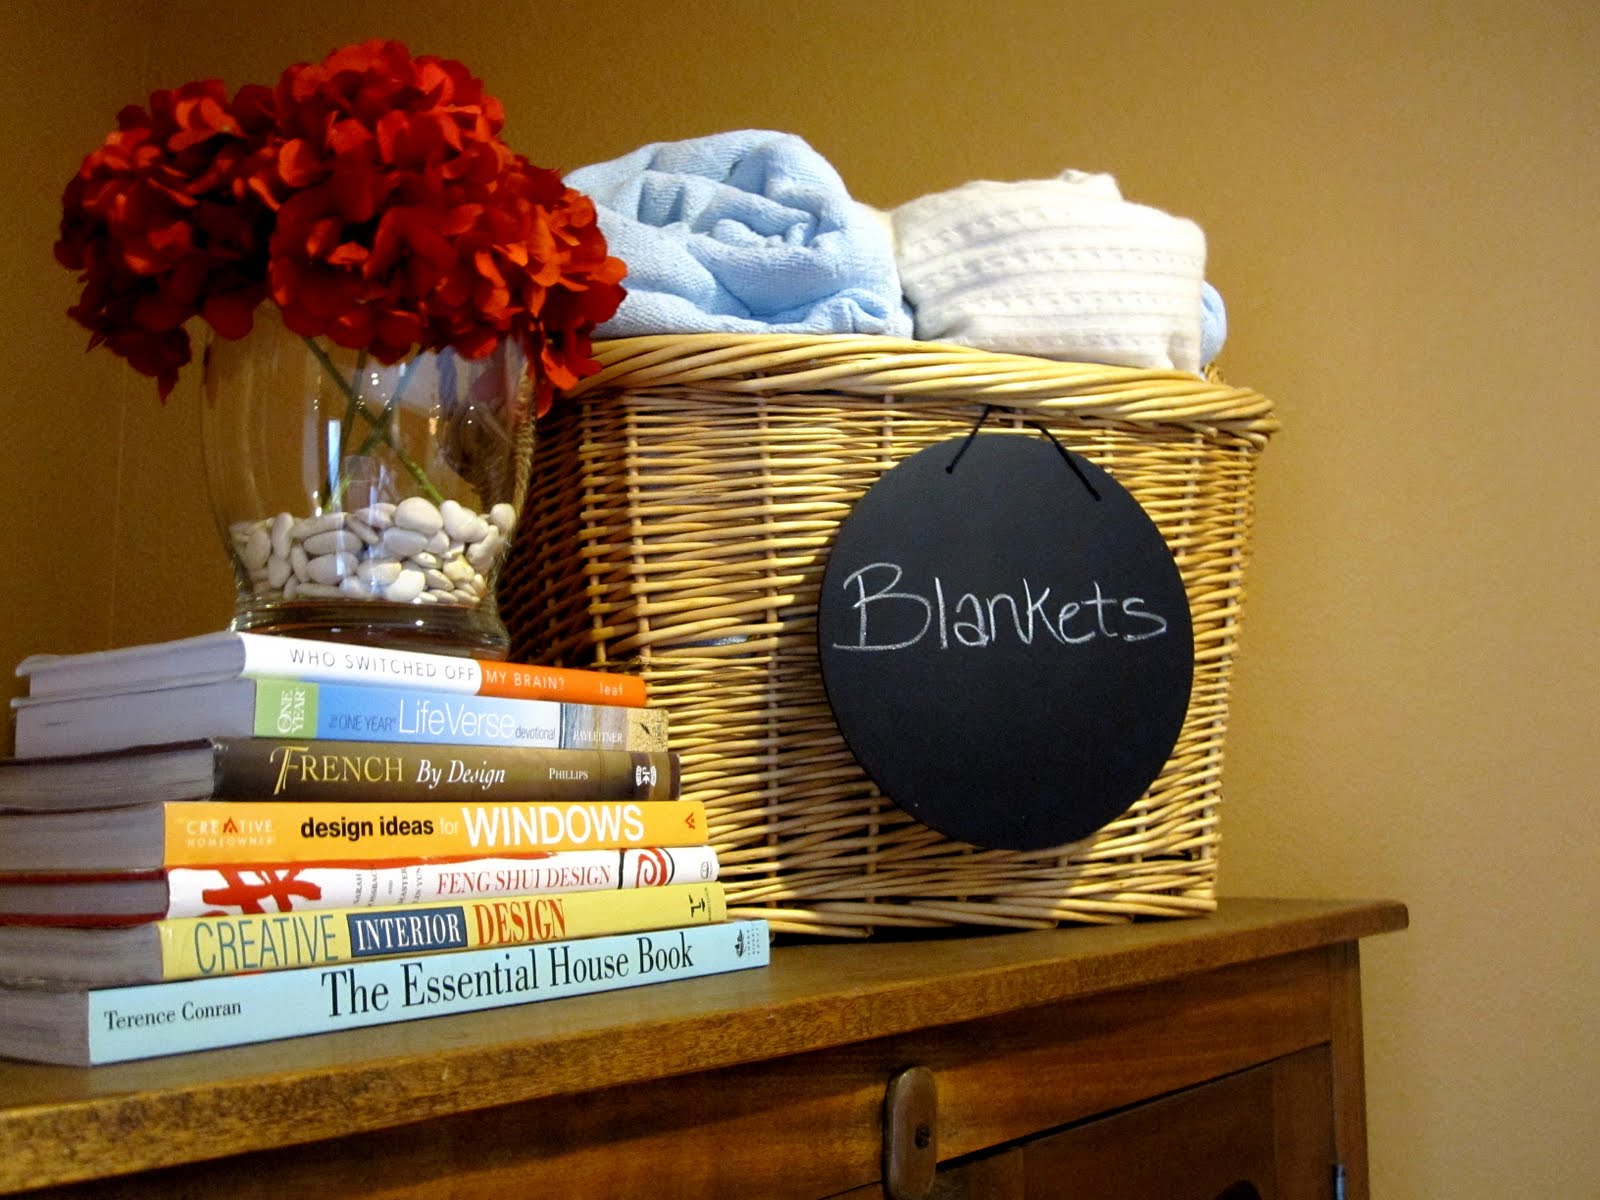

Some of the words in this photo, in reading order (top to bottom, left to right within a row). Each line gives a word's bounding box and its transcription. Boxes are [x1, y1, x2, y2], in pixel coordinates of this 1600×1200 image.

[832, 562, 1167, 651] Blankets
[289, 648, 336, 667] WHO
[345, 654, 437, 677] SWITCHED
[444, 665, 476, 681] OFF
[486, 670, 507, 683] MY
[513, 672, 565, 690] BRAIN?
[600, 683, 623, 697] leaf
[277, 690, 293, 734] ONE
[292, 688, 307, 733] YEAR
[338, 714, 362, 731] ONE
[399, 699, 515, 739] LifeVerse
[515, 725, 557, 741] devotional
[269, 746, 404, 796] FRENCH
[416, 759, 443, 789] By
[446, 760, 506, 790] Design
[300, 818, 374, 842] design
[379, 816, 435, 837] ideas
[439, 818, 459, 836] for
[462, 805, 644, 847] WINDOWS
[436, 873, 490, 895] FENG
[494, 868, 540, 890] SHUI
[546, 865, 611, 888] DESIGN
[194, 914, 339, 974] CREATIVE
[355, 913, 462, 951] INTERIOR
[472, 898, 567, 946] DESIGN
[321, 967, 389, 1018] The
[400, 948, 539, 1009] Essential
[547, 945, 630, 988] House
[636, 931, 694, 975] Book
[103, 1007, 176, 1031] Terence
[182, 1000, 242, 1021] Conran
